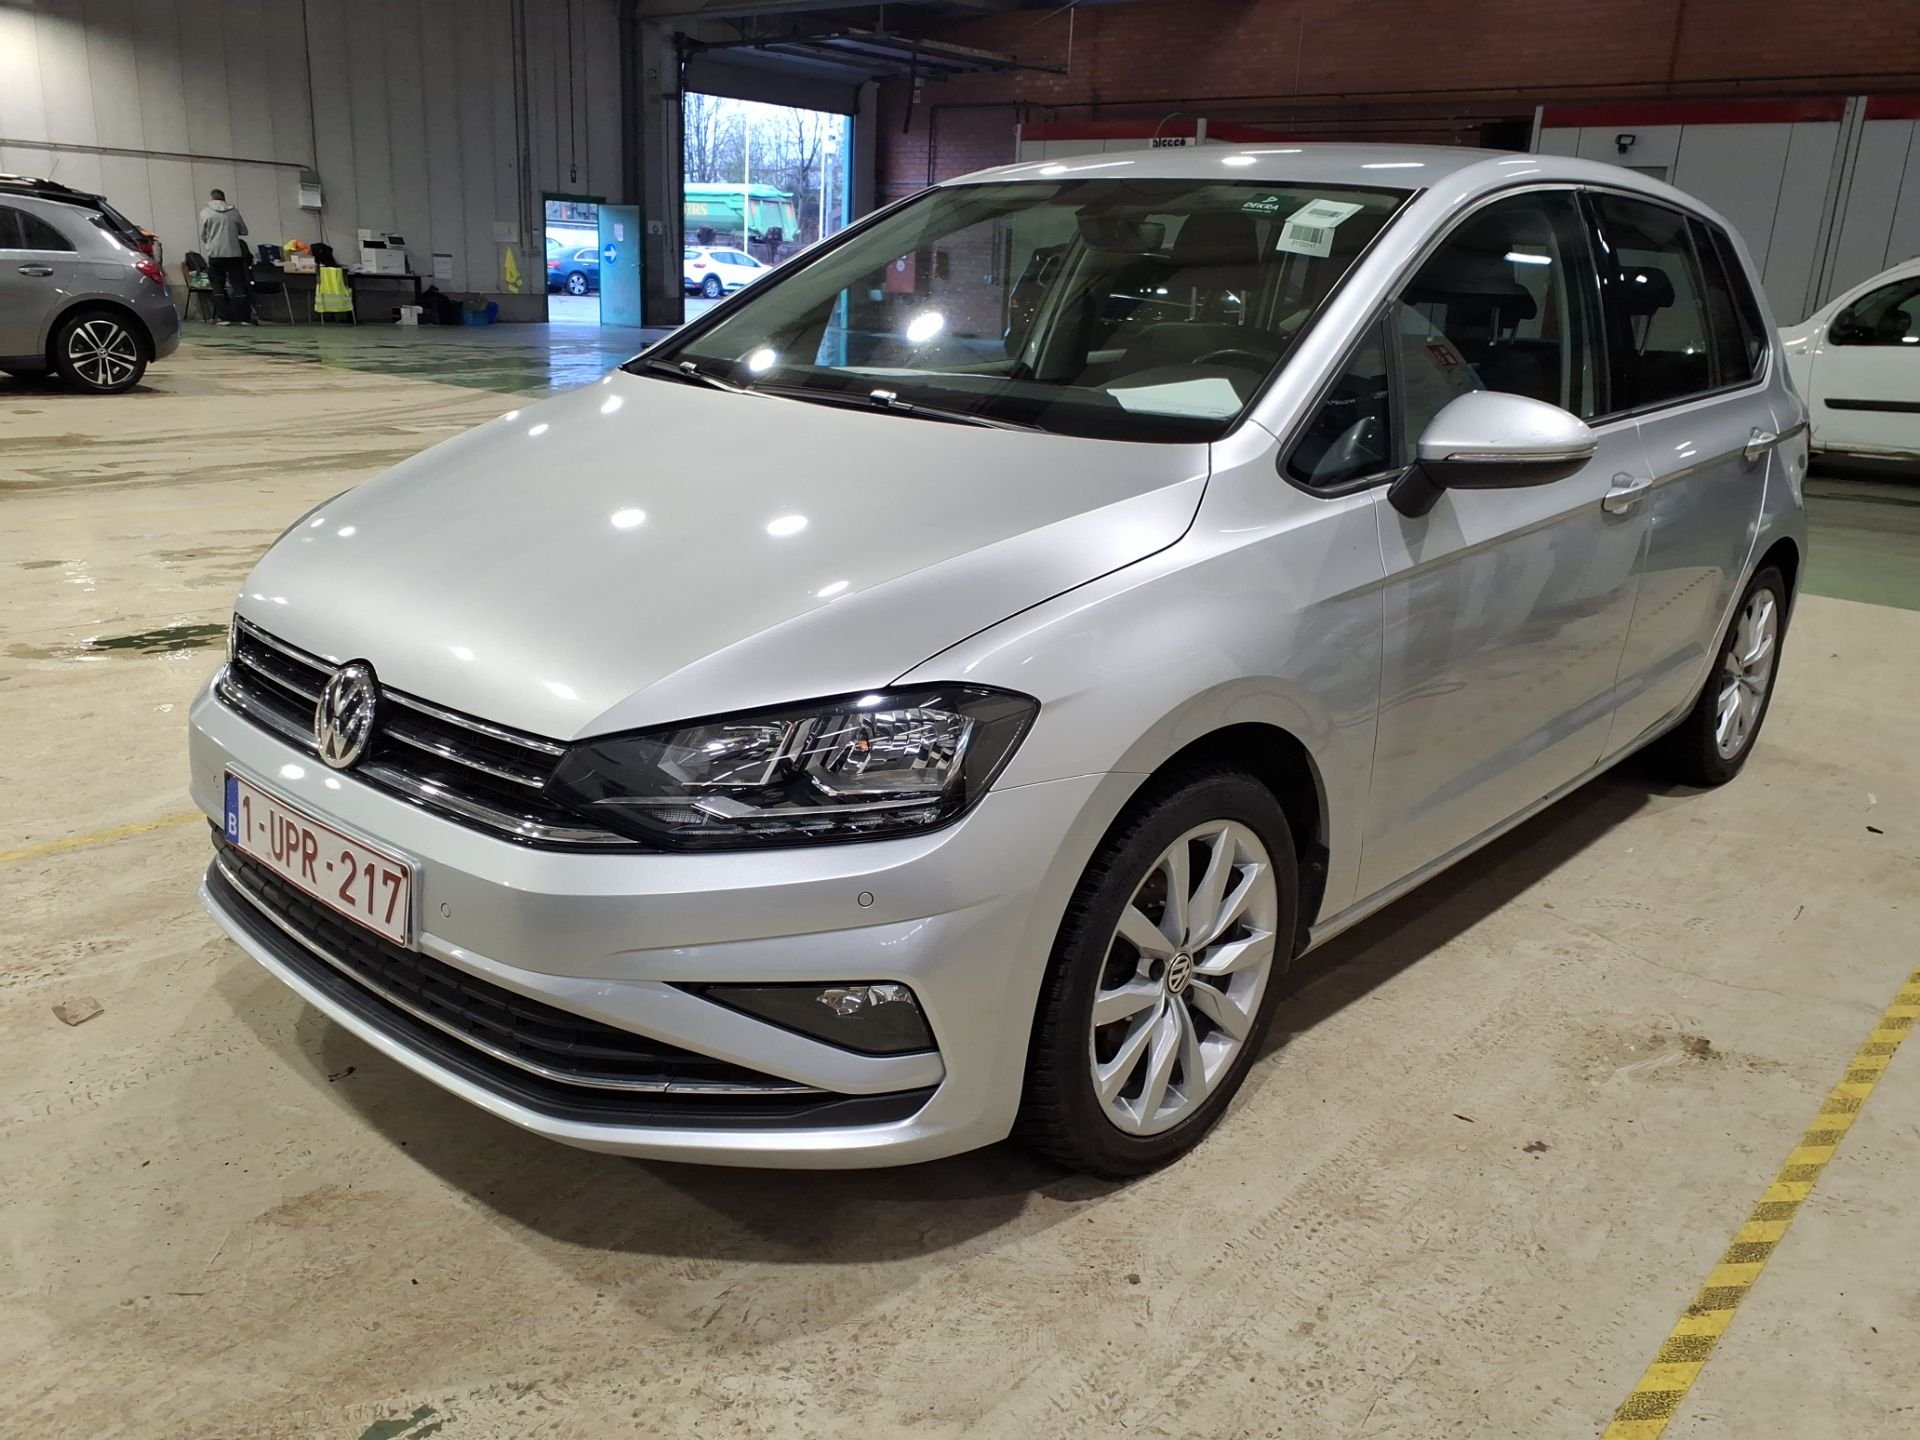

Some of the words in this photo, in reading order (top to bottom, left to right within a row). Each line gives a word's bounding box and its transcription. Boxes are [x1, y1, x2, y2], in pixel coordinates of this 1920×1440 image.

[1242, 202, 1279, 211] DEKRA
[228, 812, 237, 836] B
[242, 795, 402, 925] 1-UPR-217
